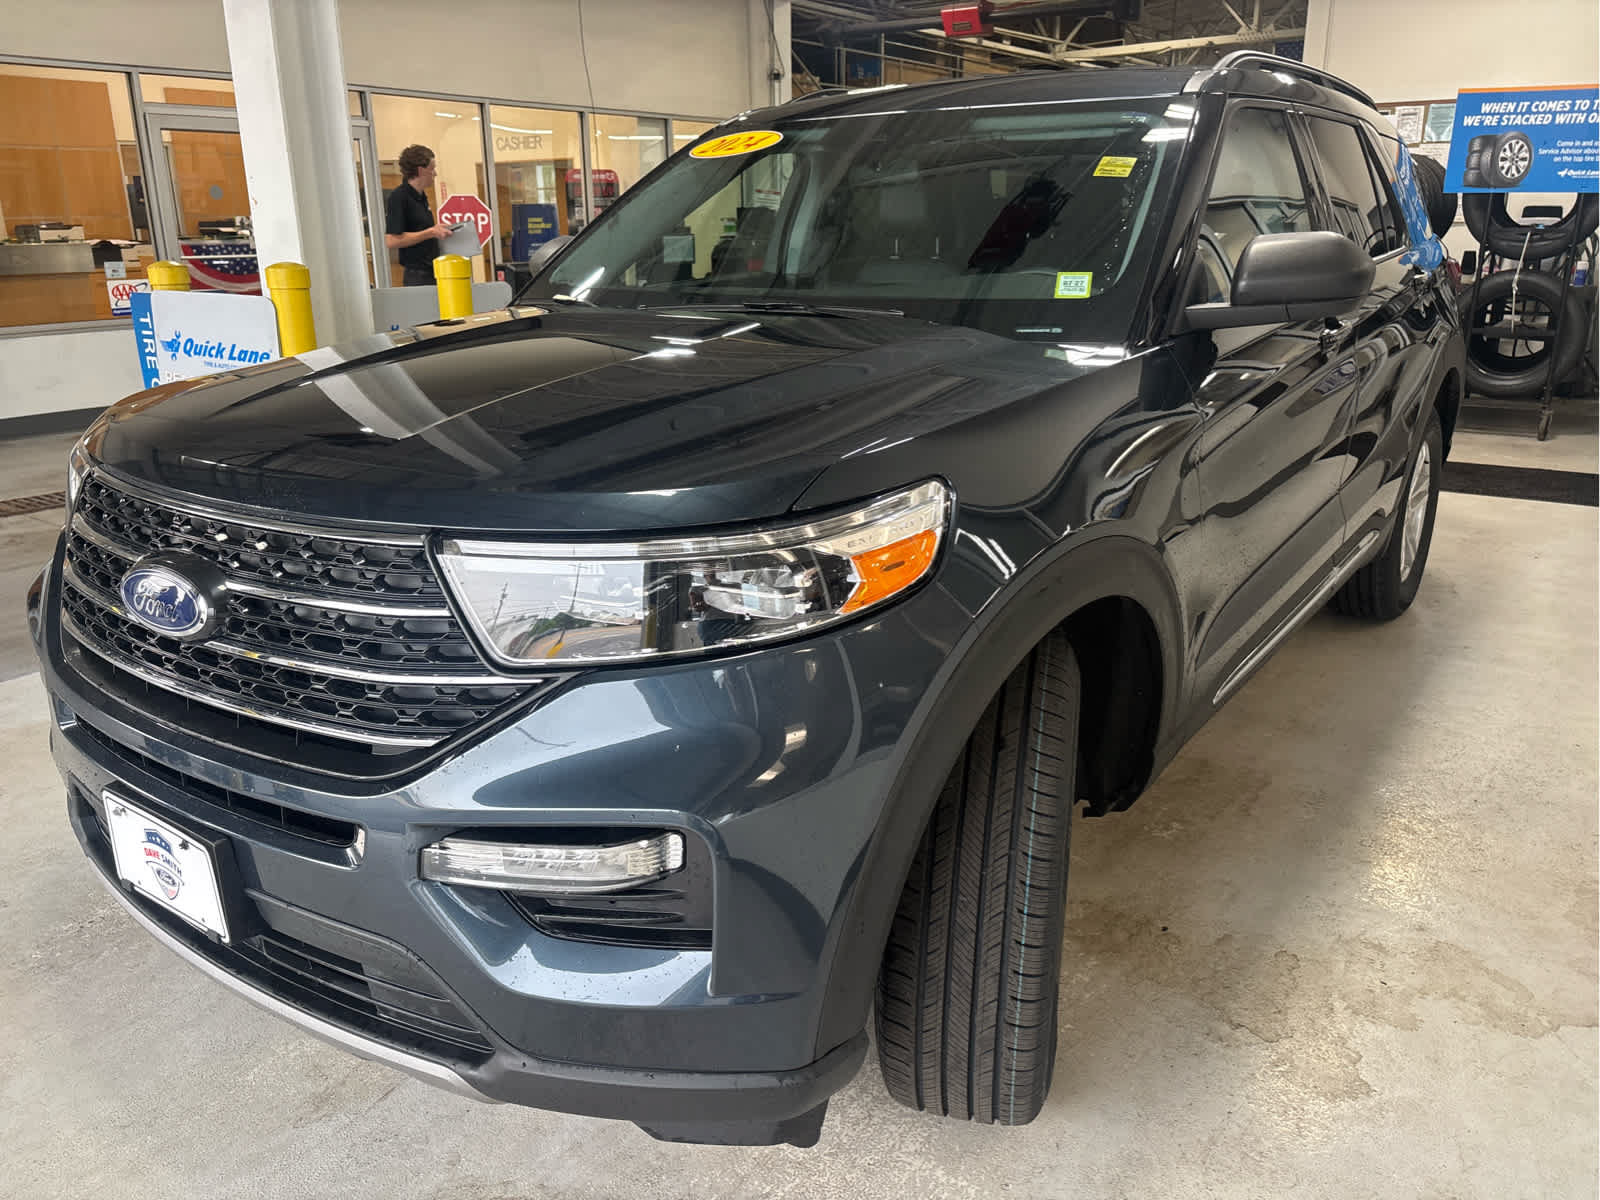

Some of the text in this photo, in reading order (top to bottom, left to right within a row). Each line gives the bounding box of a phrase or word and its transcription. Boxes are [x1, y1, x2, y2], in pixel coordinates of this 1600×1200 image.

[1481, 102, 1516, 113] WHEN
[1517, 102, 1531, 113] IT
[1531, 100, 1571, 112] COMES
[1574, 99, 1590, 111] TO
[1463, 114, 1500, 126] WE'RE
[1500, 113, 1552, 126] STACKED
[1555, 112, 1587, 125] WITH
[495, 135, 543, 151] CASHIER
[140, 312, 159, 369] TIRE
[183, 338, 271, 364] Quick Lane
